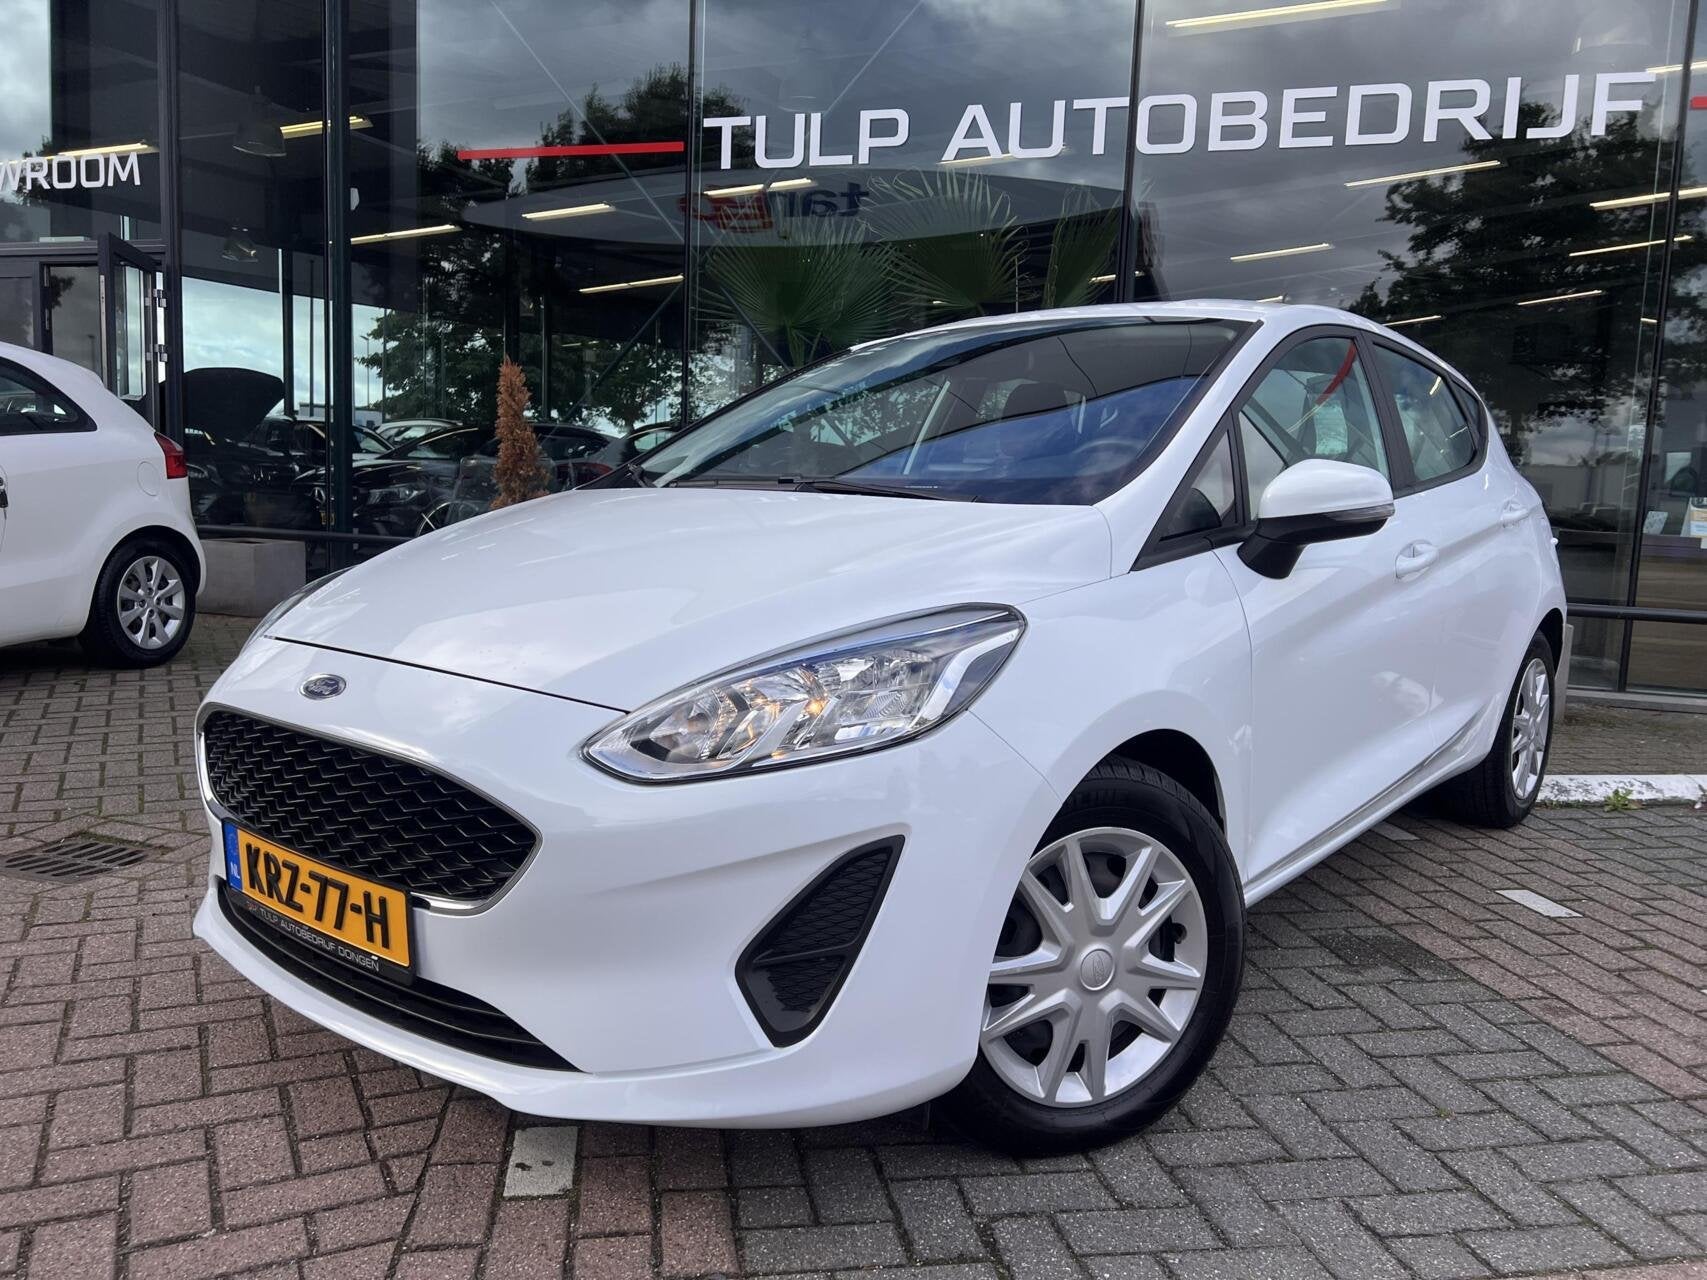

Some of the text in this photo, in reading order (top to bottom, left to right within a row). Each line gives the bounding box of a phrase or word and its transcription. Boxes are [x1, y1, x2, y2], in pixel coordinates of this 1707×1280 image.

[703, 71, 1657, 170] TULP AUTOBEDRIJF
[230, 861, 241, 879] NL
[245, 842, 390, 950] KRZ-77-H
[338, 945, 380, 973] DONGEN
